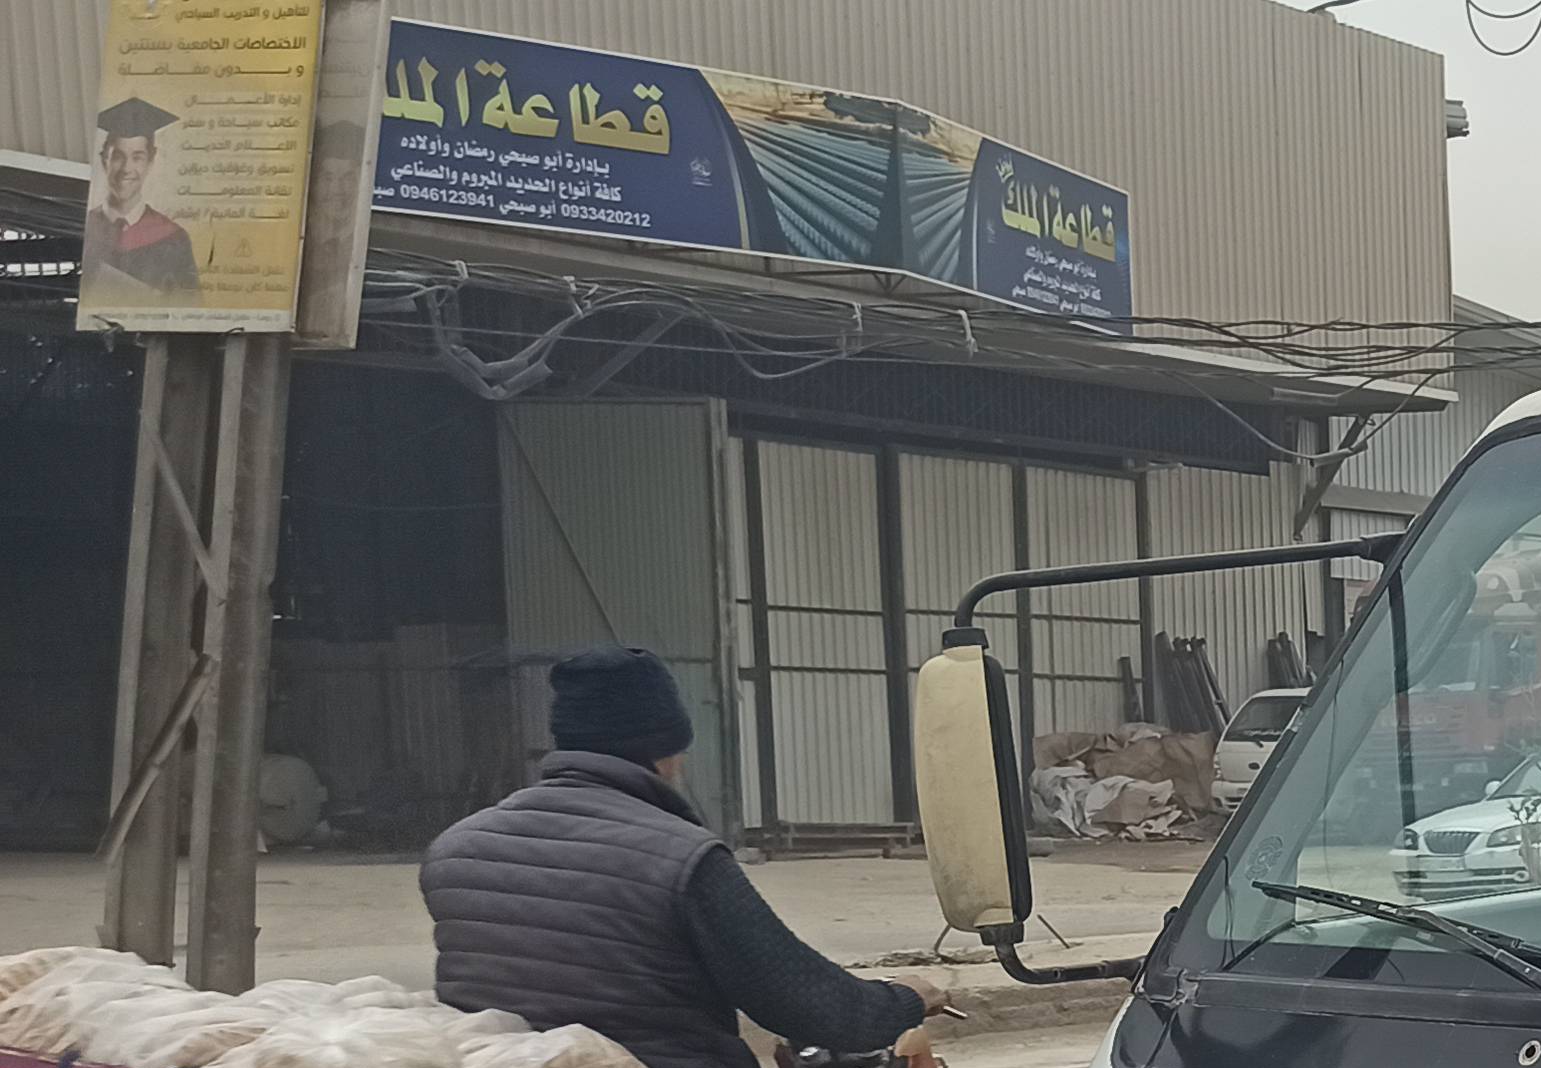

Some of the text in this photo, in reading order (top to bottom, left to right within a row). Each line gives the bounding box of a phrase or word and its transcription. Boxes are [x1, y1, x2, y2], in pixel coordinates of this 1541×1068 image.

[383, 56, 671, 155] قطاعة المل
[400, 134, 450, 157] وأولاده
[453, 140, 496, 162] رمضان
[498, 150, 540, 167] صبحي
[543, 151, 563, 172] أبو
[390, 160, 622, 202] كافة أنواع الحديد المبروم والصناعي
[400, 184, 495, 208] 0946123941
[498, 199, 536, 216] صبحي
[538, 199, 556, 219] أبو
[561, 203, 651, 227] 0933420212
[1049, 184, 1116, 262] قطاعة
